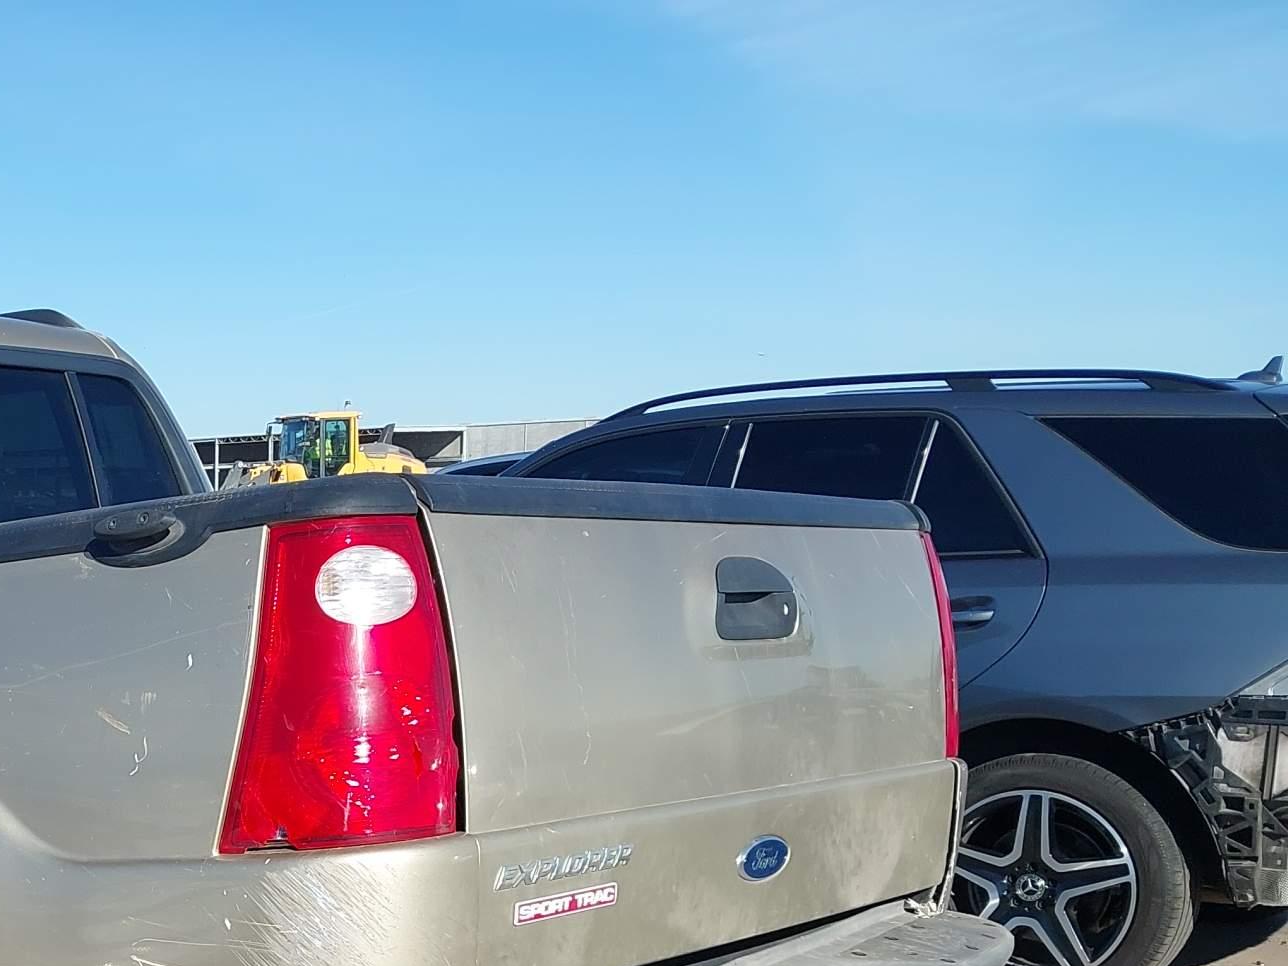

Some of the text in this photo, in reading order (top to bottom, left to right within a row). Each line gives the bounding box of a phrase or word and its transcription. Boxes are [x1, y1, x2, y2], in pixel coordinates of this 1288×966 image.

[493, 844, 633, 891] EXPLORER
[752, 848, 779, 871] Ford
[519, 887, 615, 920] SPORT TRAC
